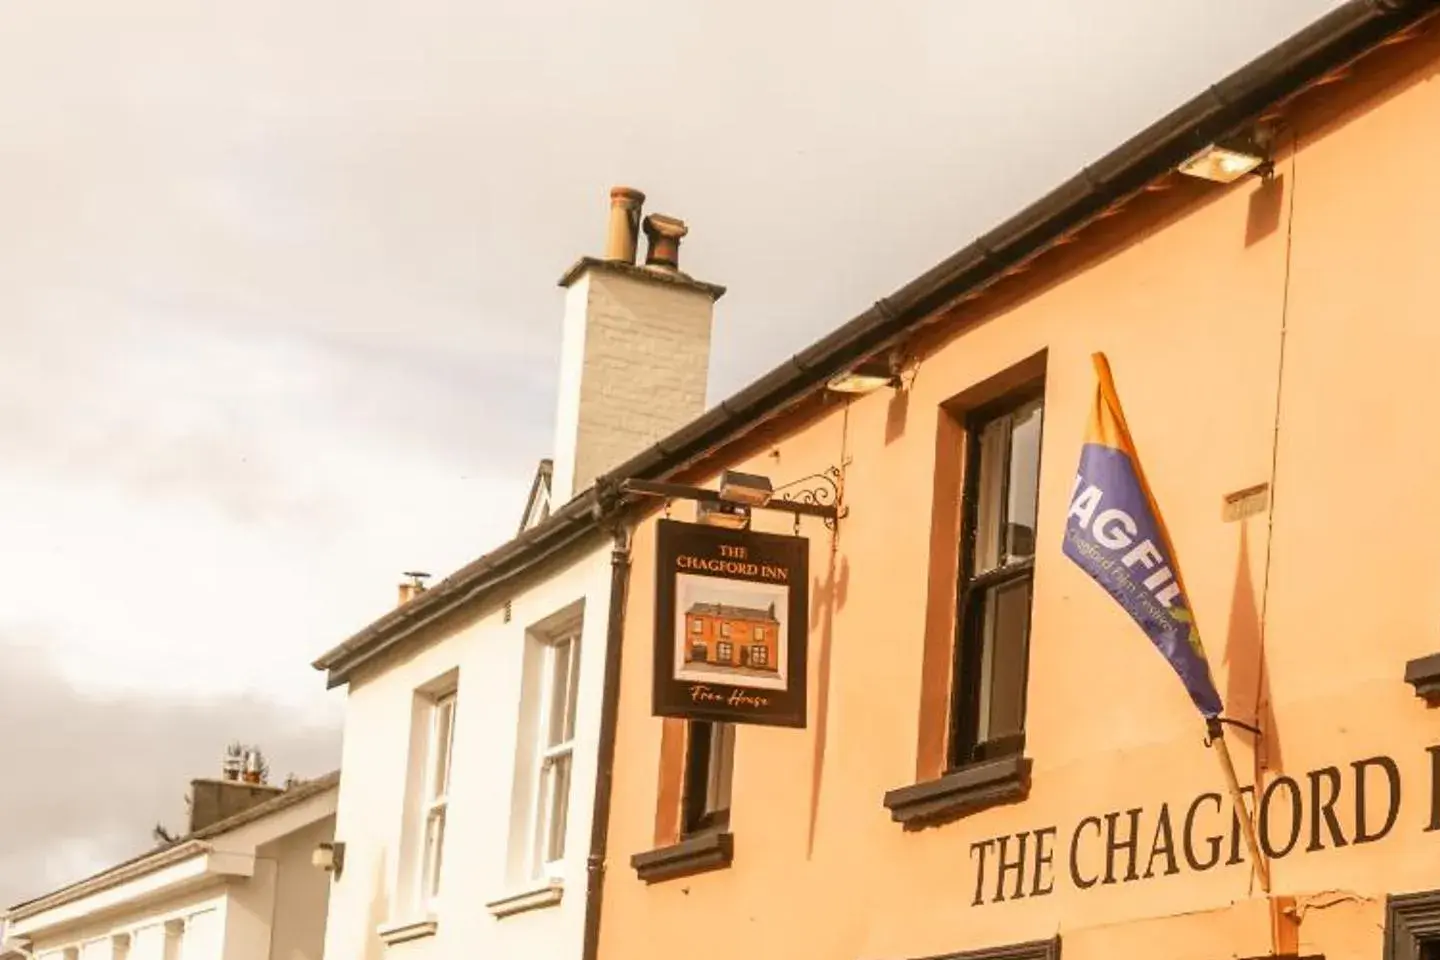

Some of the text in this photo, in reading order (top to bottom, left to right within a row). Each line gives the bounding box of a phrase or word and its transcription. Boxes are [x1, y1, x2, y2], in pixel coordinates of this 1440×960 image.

[676, 554, 789, 580] CHAGFORD INN
[719, 544, 747, 559] THE
[1068, 474, 1181, 608] AGFIL
[969, 826, 1057, 906] THE
